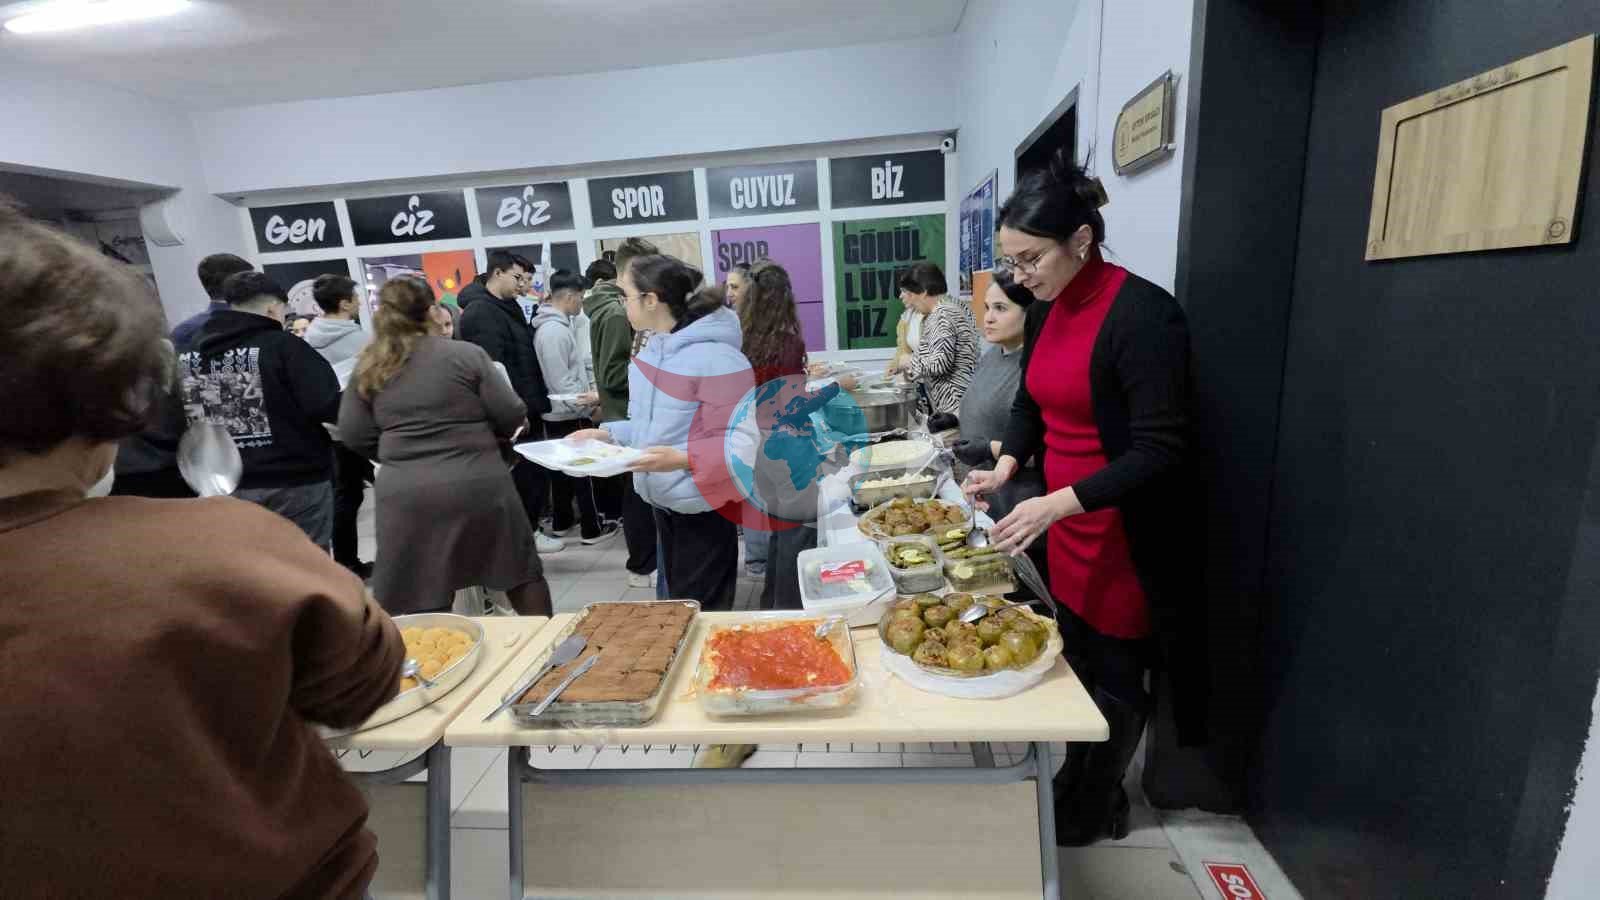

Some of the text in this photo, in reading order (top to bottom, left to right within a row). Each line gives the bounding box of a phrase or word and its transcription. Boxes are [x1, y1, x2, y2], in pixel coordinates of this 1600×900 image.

[729, 174, 796, 210] CUYUZ
[871, 160, 904, 200] BİZ
[496, 185, 552, 229] Biz
[611, 185, 667, 220] SPOR
[264, 214, 326, 245] Gen
[844, 226, 927, 265] GÖNÜL
